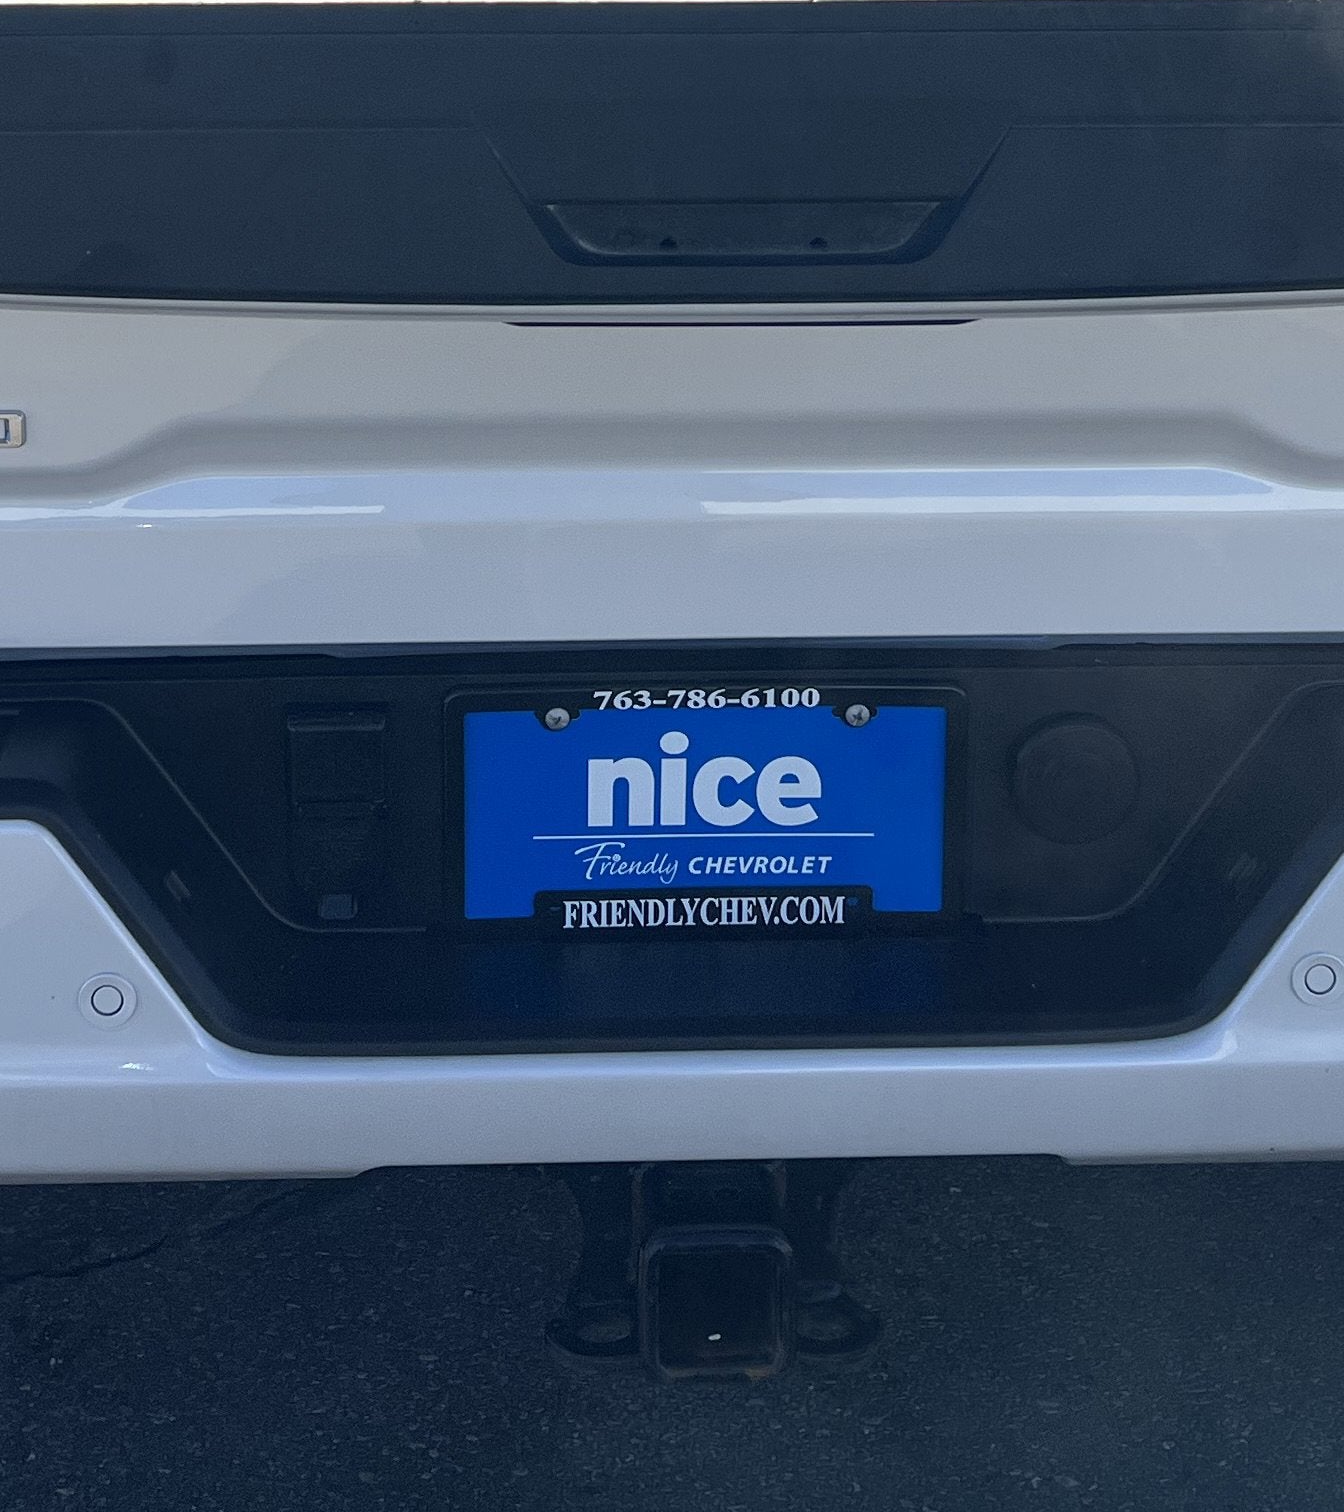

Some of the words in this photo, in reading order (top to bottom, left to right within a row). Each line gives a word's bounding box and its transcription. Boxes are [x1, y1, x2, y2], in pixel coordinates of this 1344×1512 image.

[593, 687, 820, 711] 763-786-6100
[587, 730, 822, 828] nice
[574, 841, 679, 884] Friendly
[688, 855, 832, 875] CHEVROLET
[562, 895, 845, 929] FRIENDLYCHEV.COM
